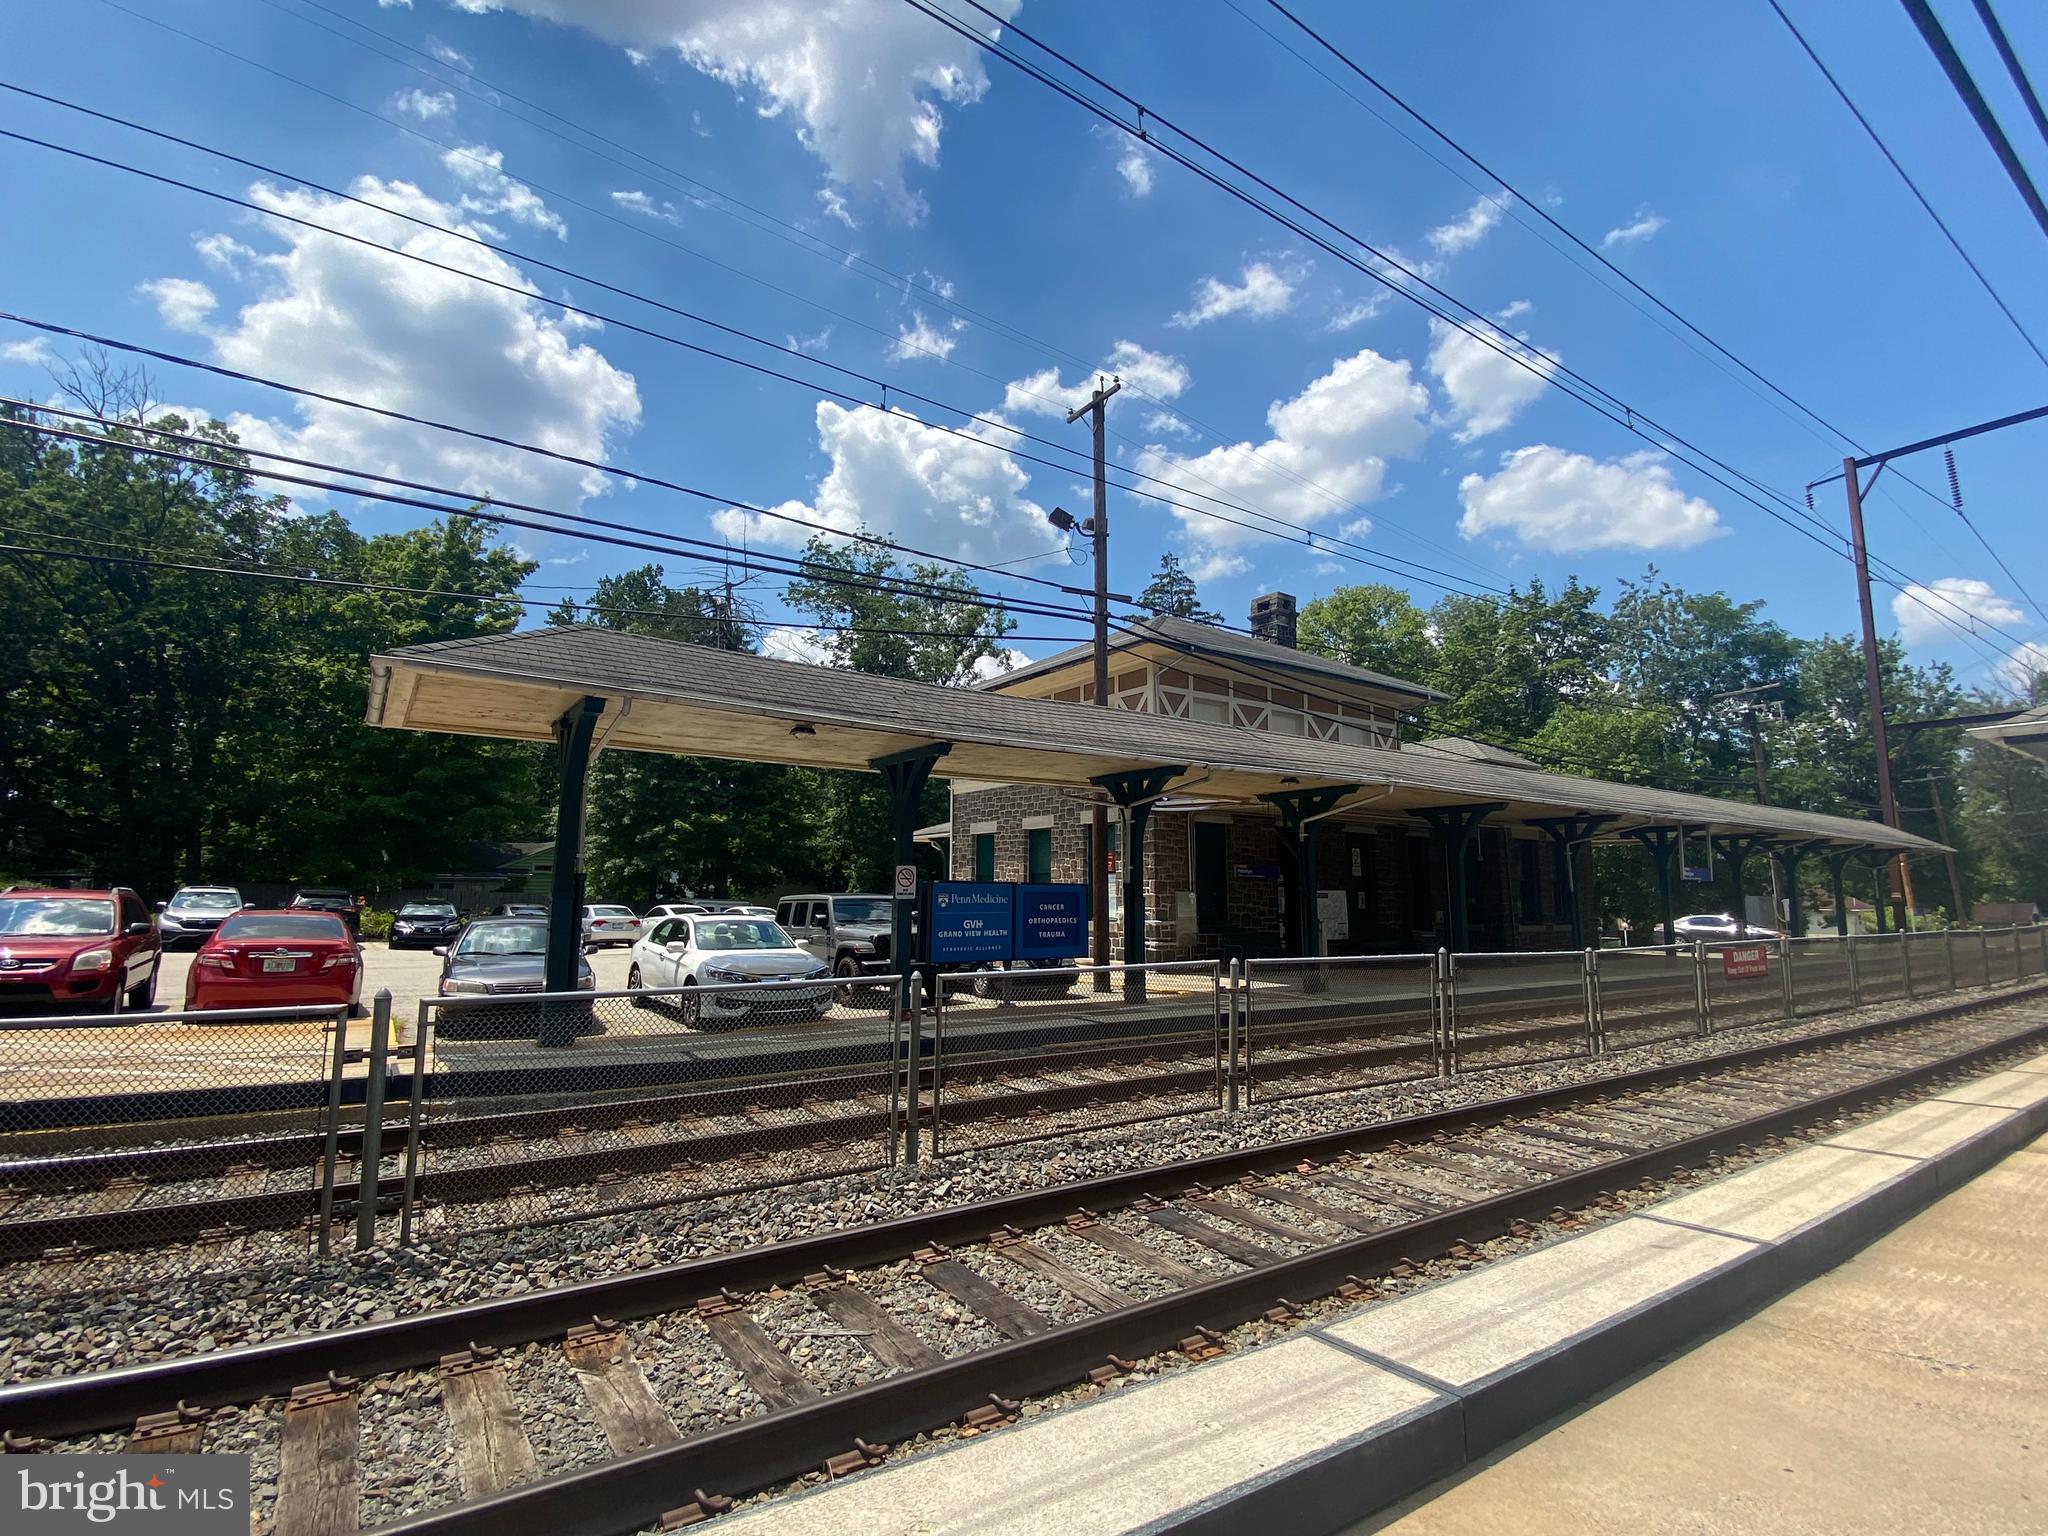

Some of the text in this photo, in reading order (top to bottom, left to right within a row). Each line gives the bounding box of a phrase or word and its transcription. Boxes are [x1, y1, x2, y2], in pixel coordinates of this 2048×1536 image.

[951, 893, 1008, 904] Penn Medicine
[1039, 903, 1065, 911] CANCER
[938, 930, 963, 938] GRAND
[983, 929, 1008, 937] HEALTH
[1733, 950, 1760, 962] DANGER
